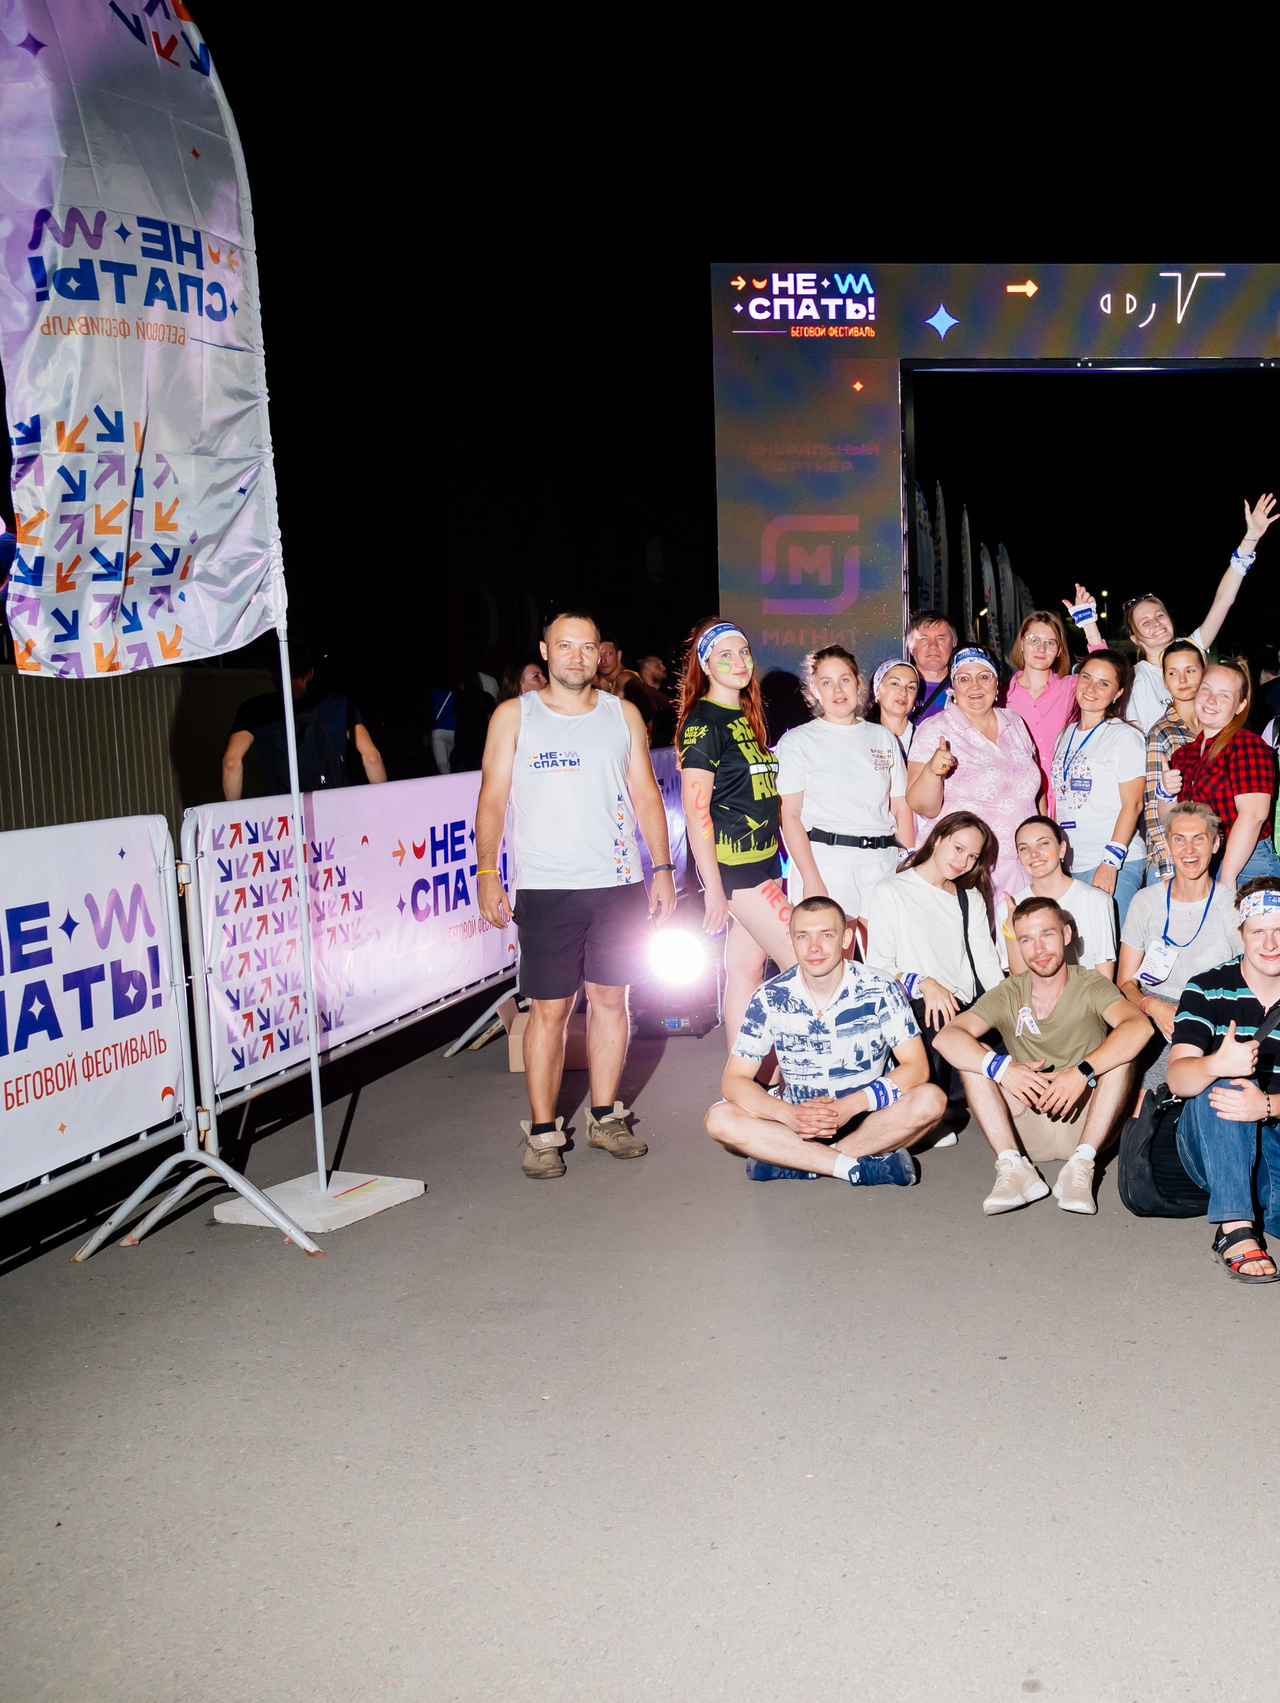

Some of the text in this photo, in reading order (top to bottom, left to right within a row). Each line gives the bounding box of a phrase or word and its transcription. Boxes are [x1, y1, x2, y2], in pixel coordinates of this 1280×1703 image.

[771, 272, 817, 295] НЕ
[748, 297, 876, 320] СПАТЬ!
[790, 325, 876, 338] БЕГОВОЙ ФЕСТИВАЛЬ
[533, 758, 580, 768] СПАТЬ!
[540, 752, 557, 760] НЕ
[430, 820, 467, 867] НЕ
[411, 853, 508, 923] СПА!
[0, 901, 53, 977] Е
[3, 1028, 168, 1112] БЕГОВОЙ ФЕСТИВАЛЬ
